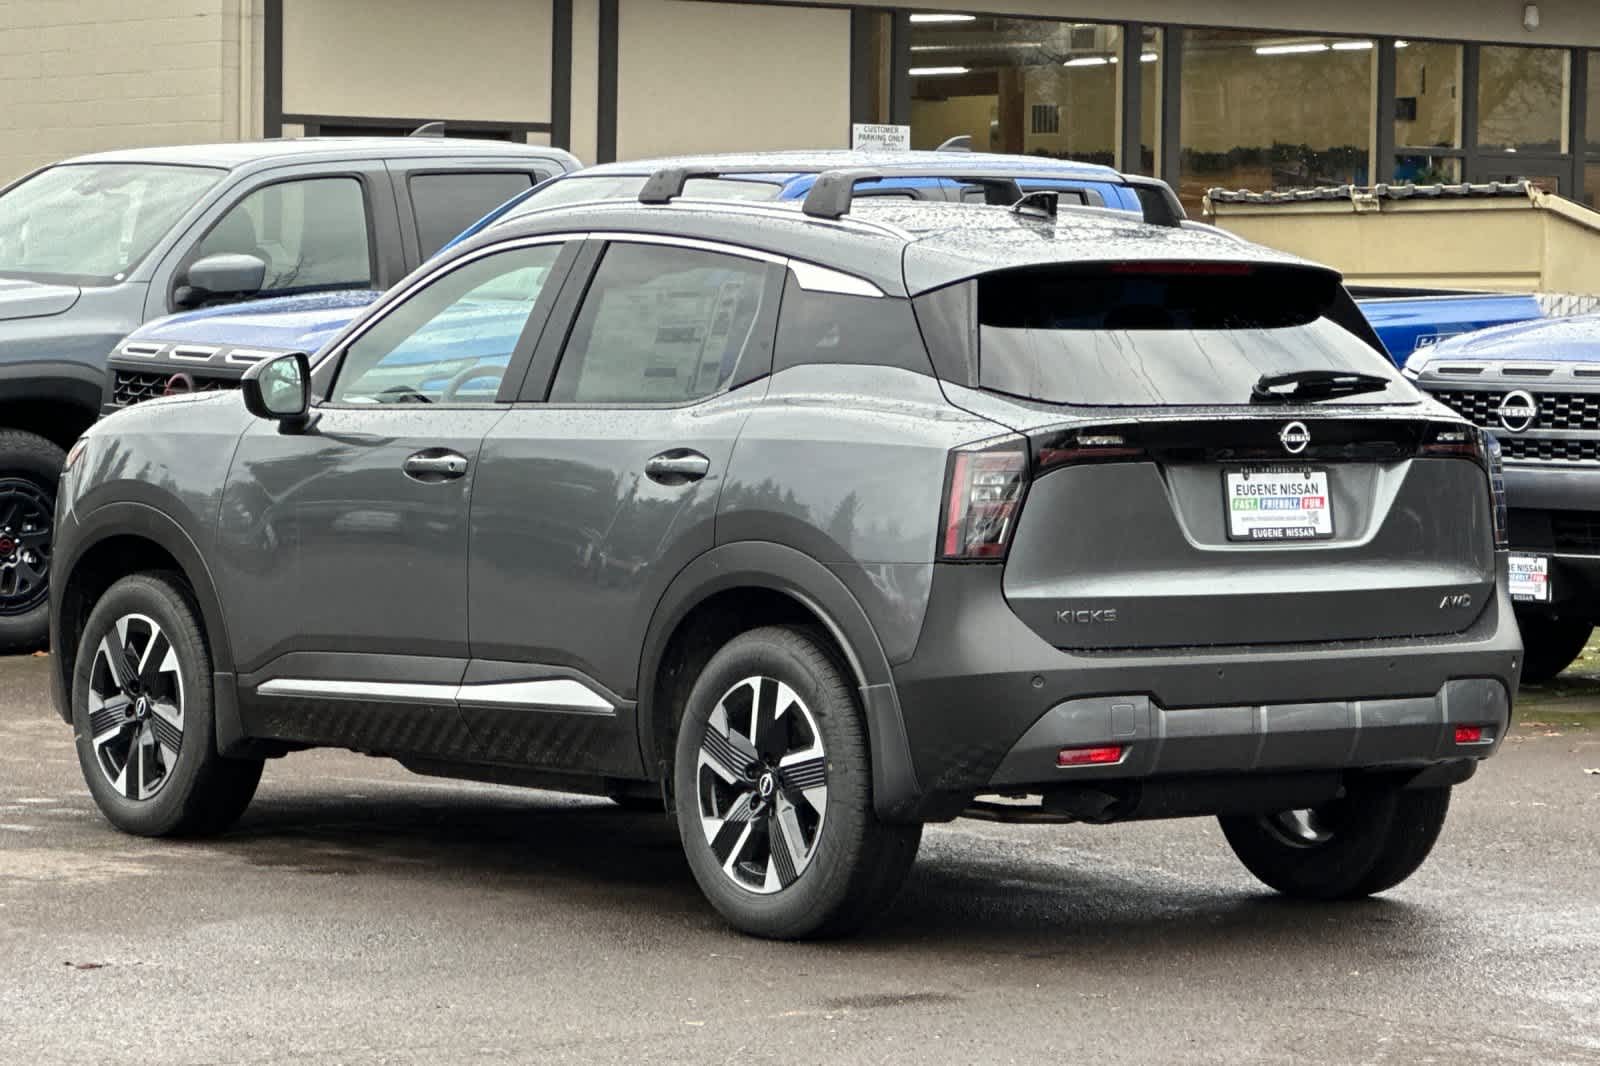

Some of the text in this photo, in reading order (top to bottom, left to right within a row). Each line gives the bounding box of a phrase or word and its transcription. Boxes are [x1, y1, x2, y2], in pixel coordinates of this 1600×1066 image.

[863, 125, 899, 133] CUSTOMER
[858, 133, 904, 142] PARKING ONLY
[1498, 407, 1536, 417] NISSAN
[1280, 433, 1311, 442] NISSAN
[1235, 482, 1319, 496] EUGENE NISSAN
[1252, 527, 1315, 538] EUGENE NISSAN
[1517, 564, 1544, 572] NISSAN
[1439, 594, 1471, 608] AWD
[1056, 609, 1117, 624] KICKS
